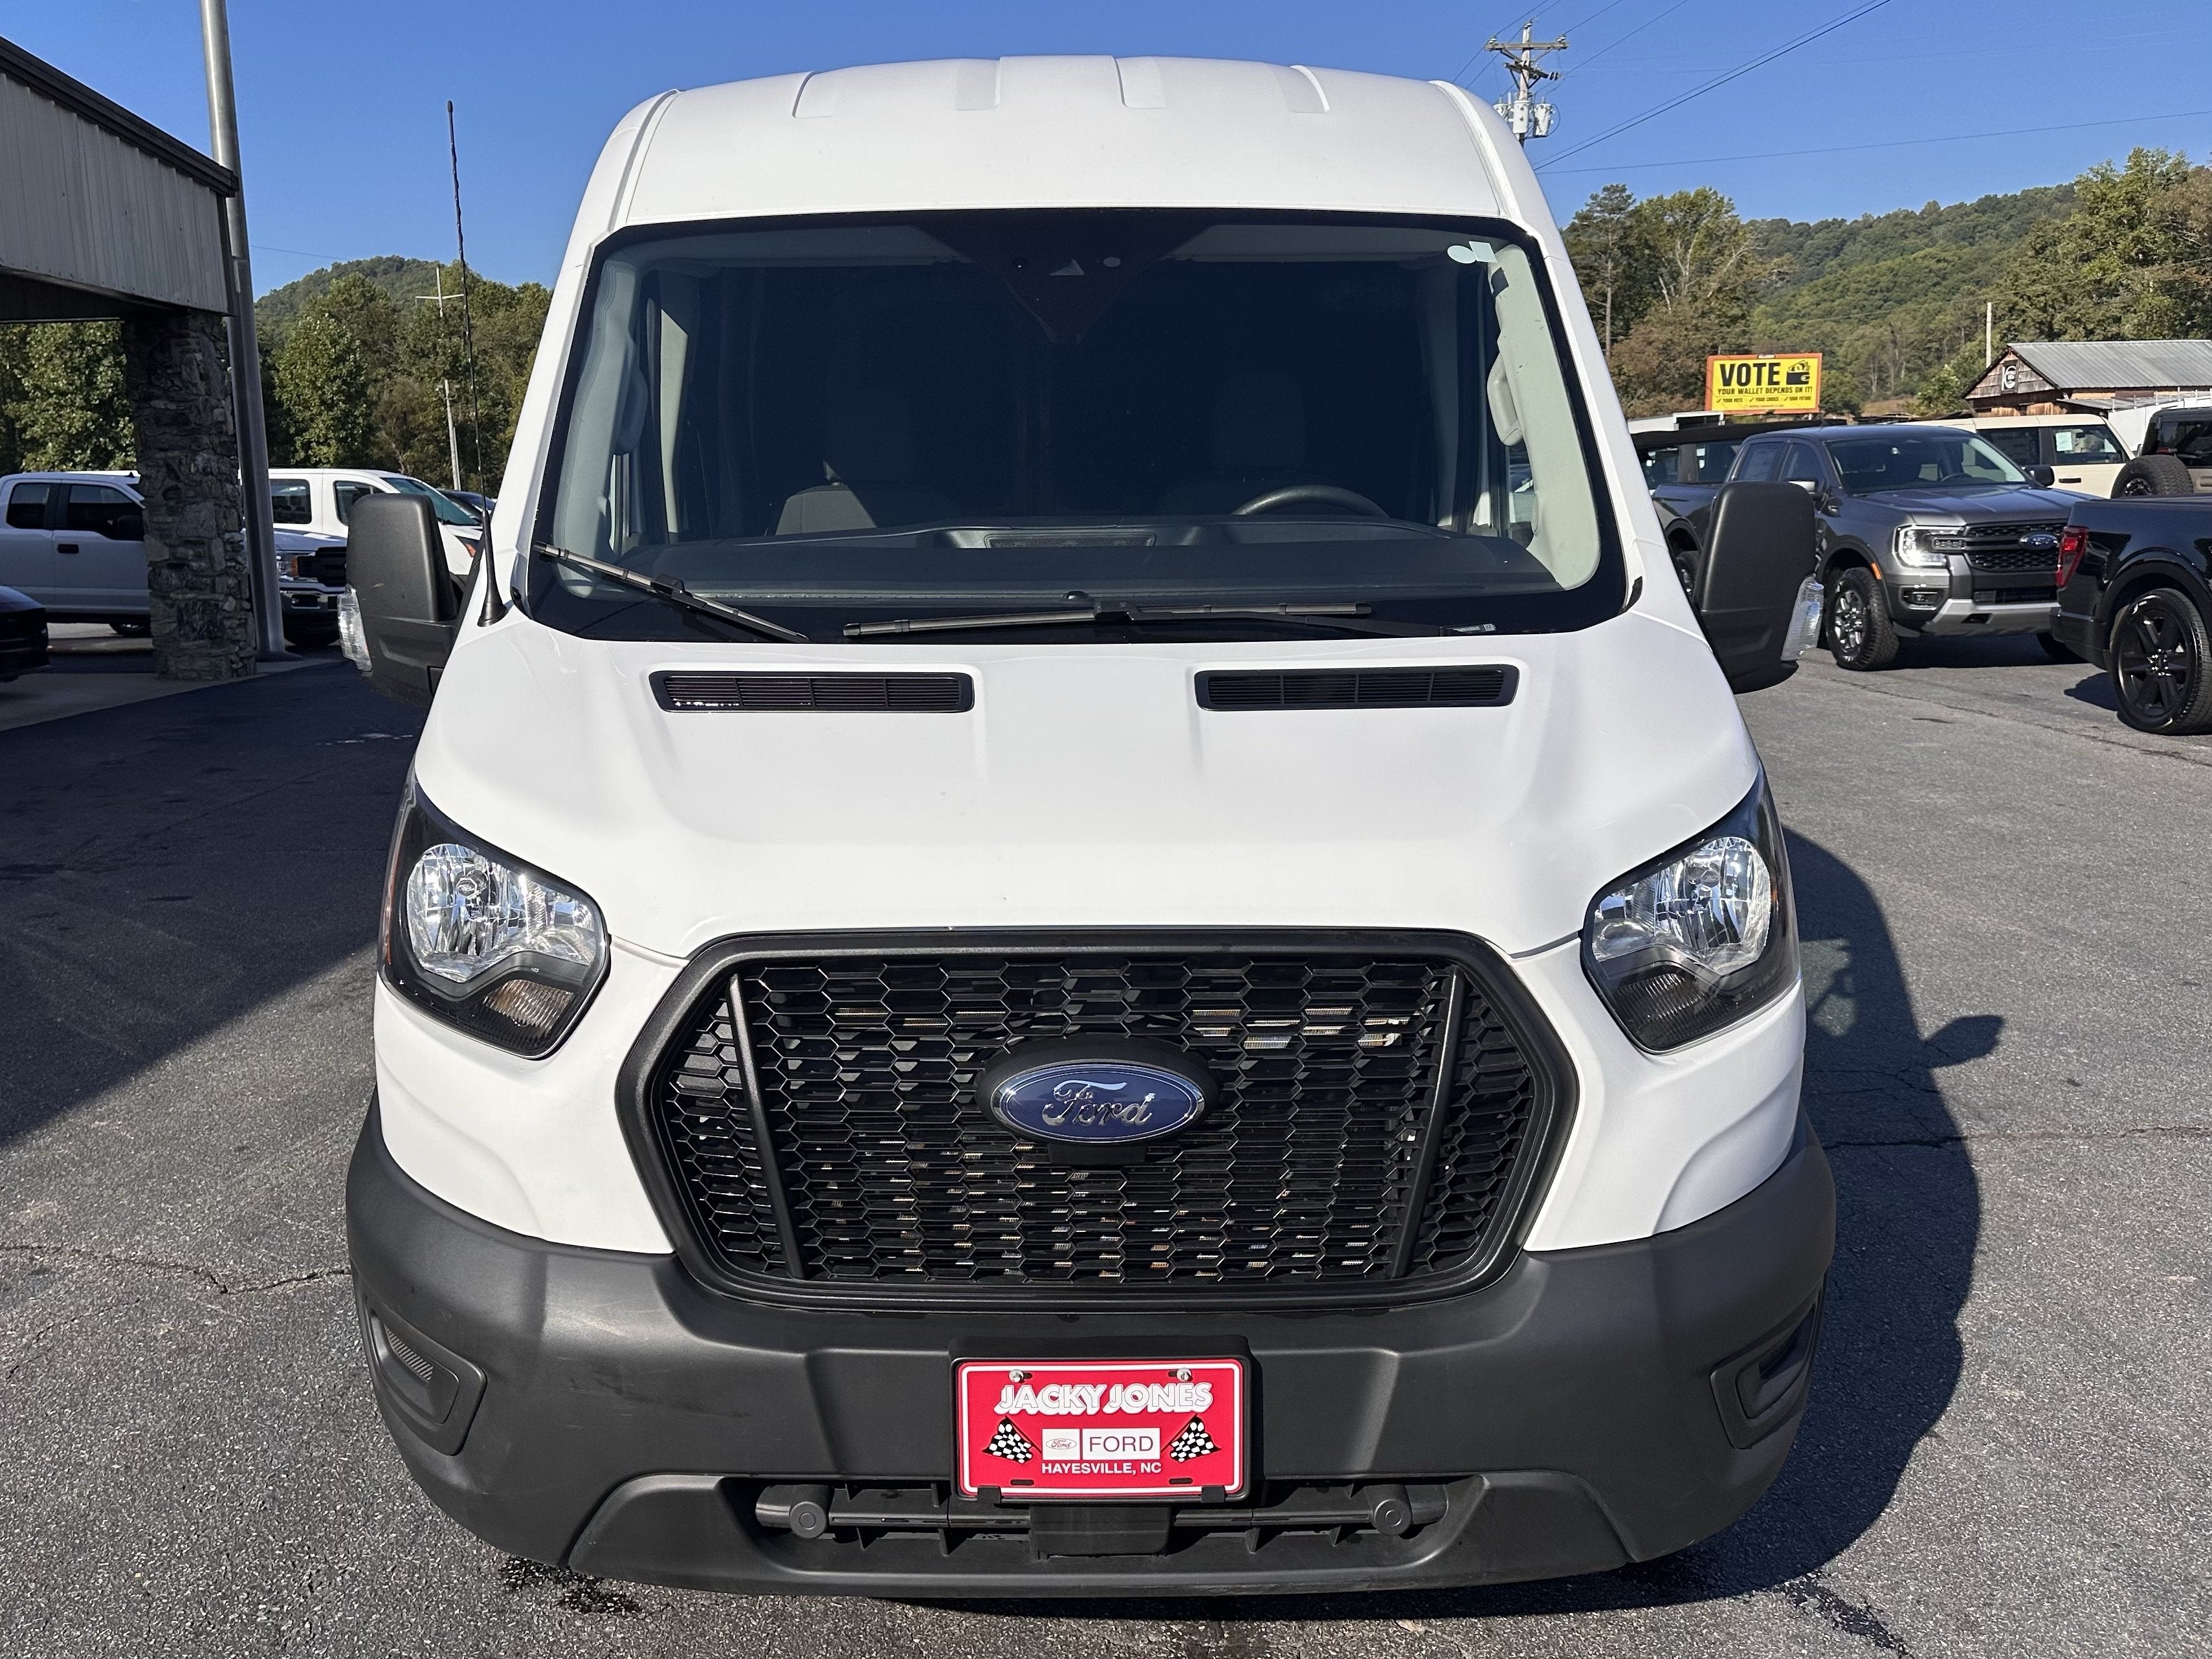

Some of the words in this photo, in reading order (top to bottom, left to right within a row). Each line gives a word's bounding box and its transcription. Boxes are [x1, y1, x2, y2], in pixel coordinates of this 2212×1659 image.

[1720, 362, 1781, 386] VOTE
[1042, 1079, 1156, 1126] Ford
[993, 1383, 1107, 1415] JACKY
[1102, 1382, 1213, 1414] JONES
[1051, 1438, 1072, 1447] Ford
[1089, 1436, 1154, 1453] FORD
[1041, 1462, 1137, 1475] HAYESVILLE,
[1140, 1462, 1162, 1474] NC
